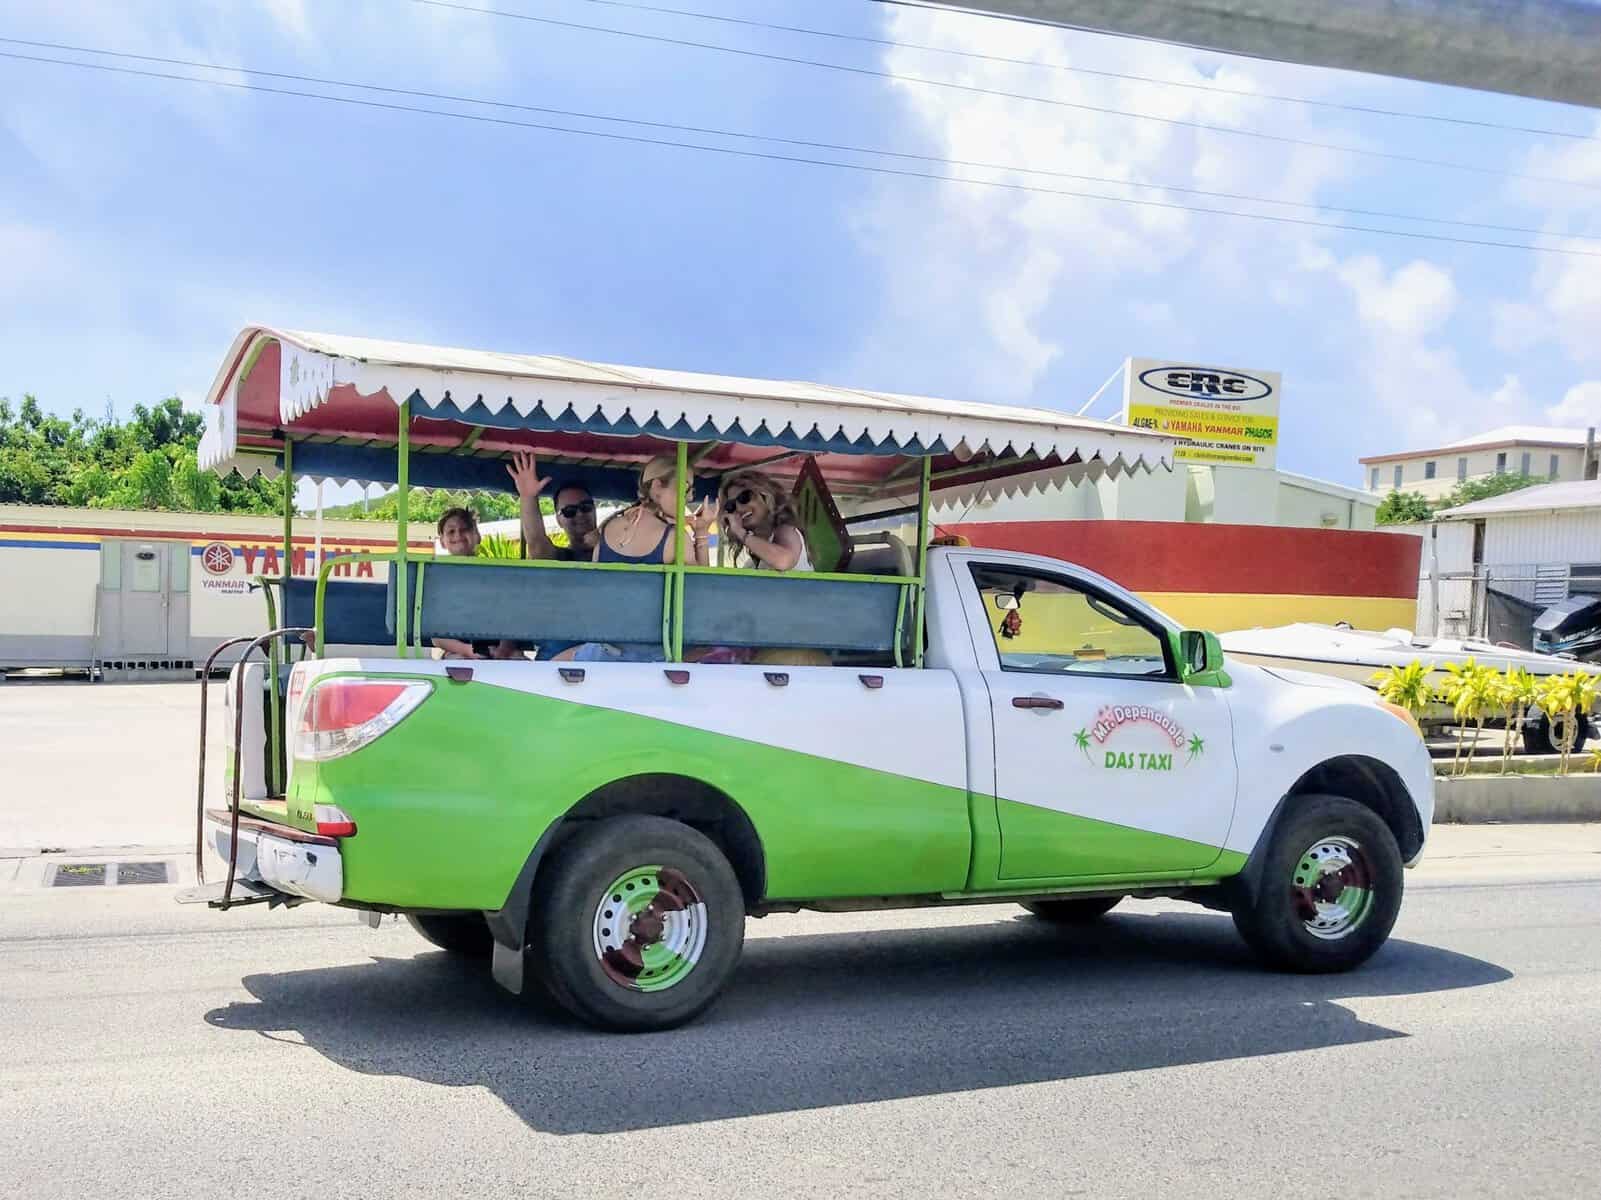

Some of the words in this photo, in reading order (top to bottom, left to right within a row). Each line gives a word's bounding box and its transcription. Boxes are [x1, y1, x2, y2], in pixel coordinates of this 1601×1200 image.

[1170, 420, 1203, 433] YAMAHA
[1204, 424, 1244, 436] YANMAR
[1178, 440, 1214, 449] HYDRAULIC
[1215, 442, 1240, 451] CRANES
[201, 579, 245, 589] YANMAR
[1091, 719, 1116, 744] Mr.
[1113, 705, 1186, 748] Dependable
[1104, 751, 1134, 769] DAS
[1139, 752, 1173, 771] TAXI
